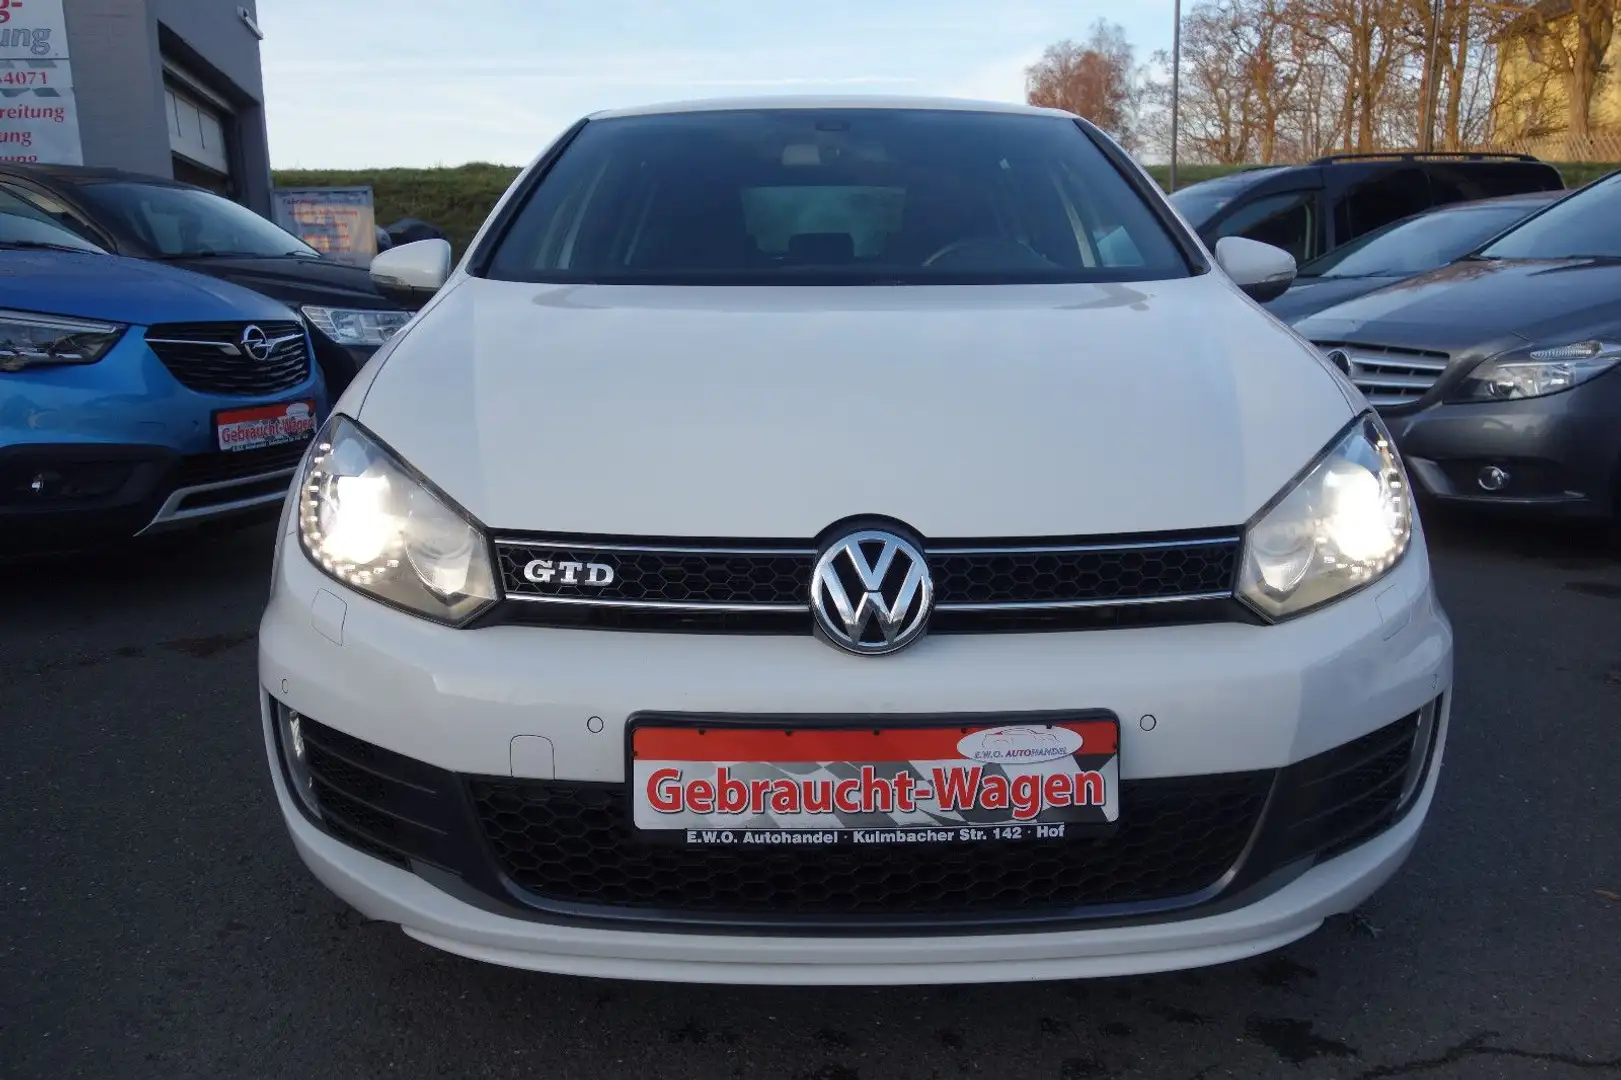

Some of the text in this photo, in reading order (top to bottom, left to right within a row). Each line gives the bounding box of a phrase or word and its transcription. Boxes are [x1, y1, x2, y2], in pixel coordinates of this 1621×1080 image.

[523, 559, 615, 587] GTD
[646, 765, 1107, 820] Gebraucht-Wagen
[686, 824, 1066, 844] E.W.O. Autohandel Kulmbacher Str. 142 Hof
